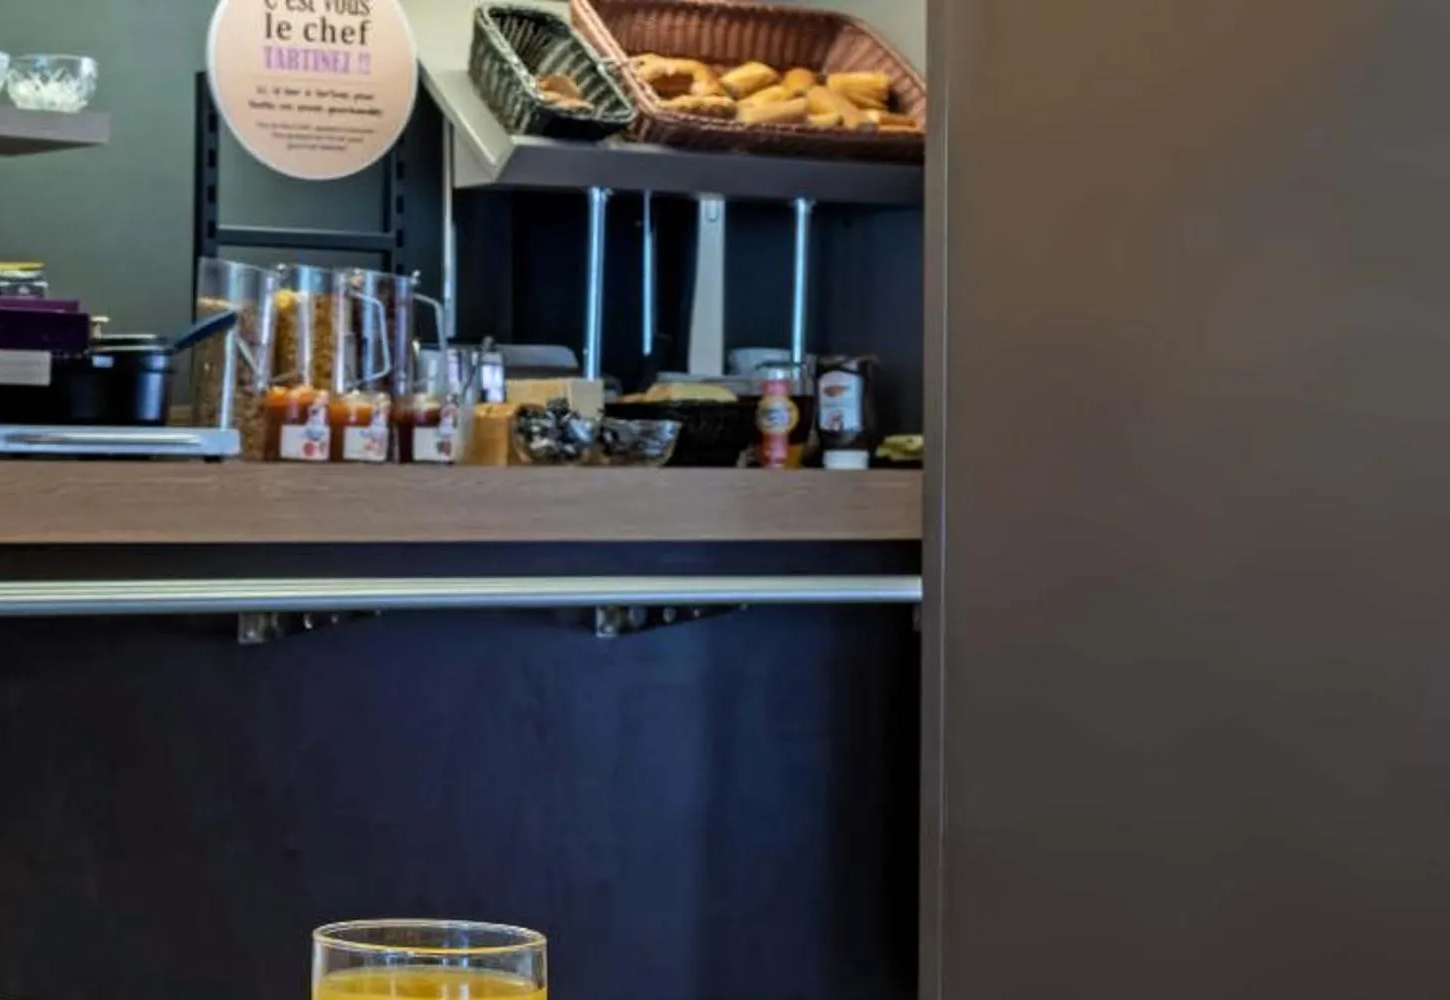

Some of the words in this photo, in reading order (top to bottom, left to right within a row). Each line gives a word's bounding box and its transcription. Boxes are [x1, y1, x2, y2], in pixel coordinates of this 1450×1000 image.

[264, 0, 315, 12] est
[265, 12, 292, 41] le
[302, 16, 372, 45] chef
[263, 46, 350, 75] TARTINEZ
